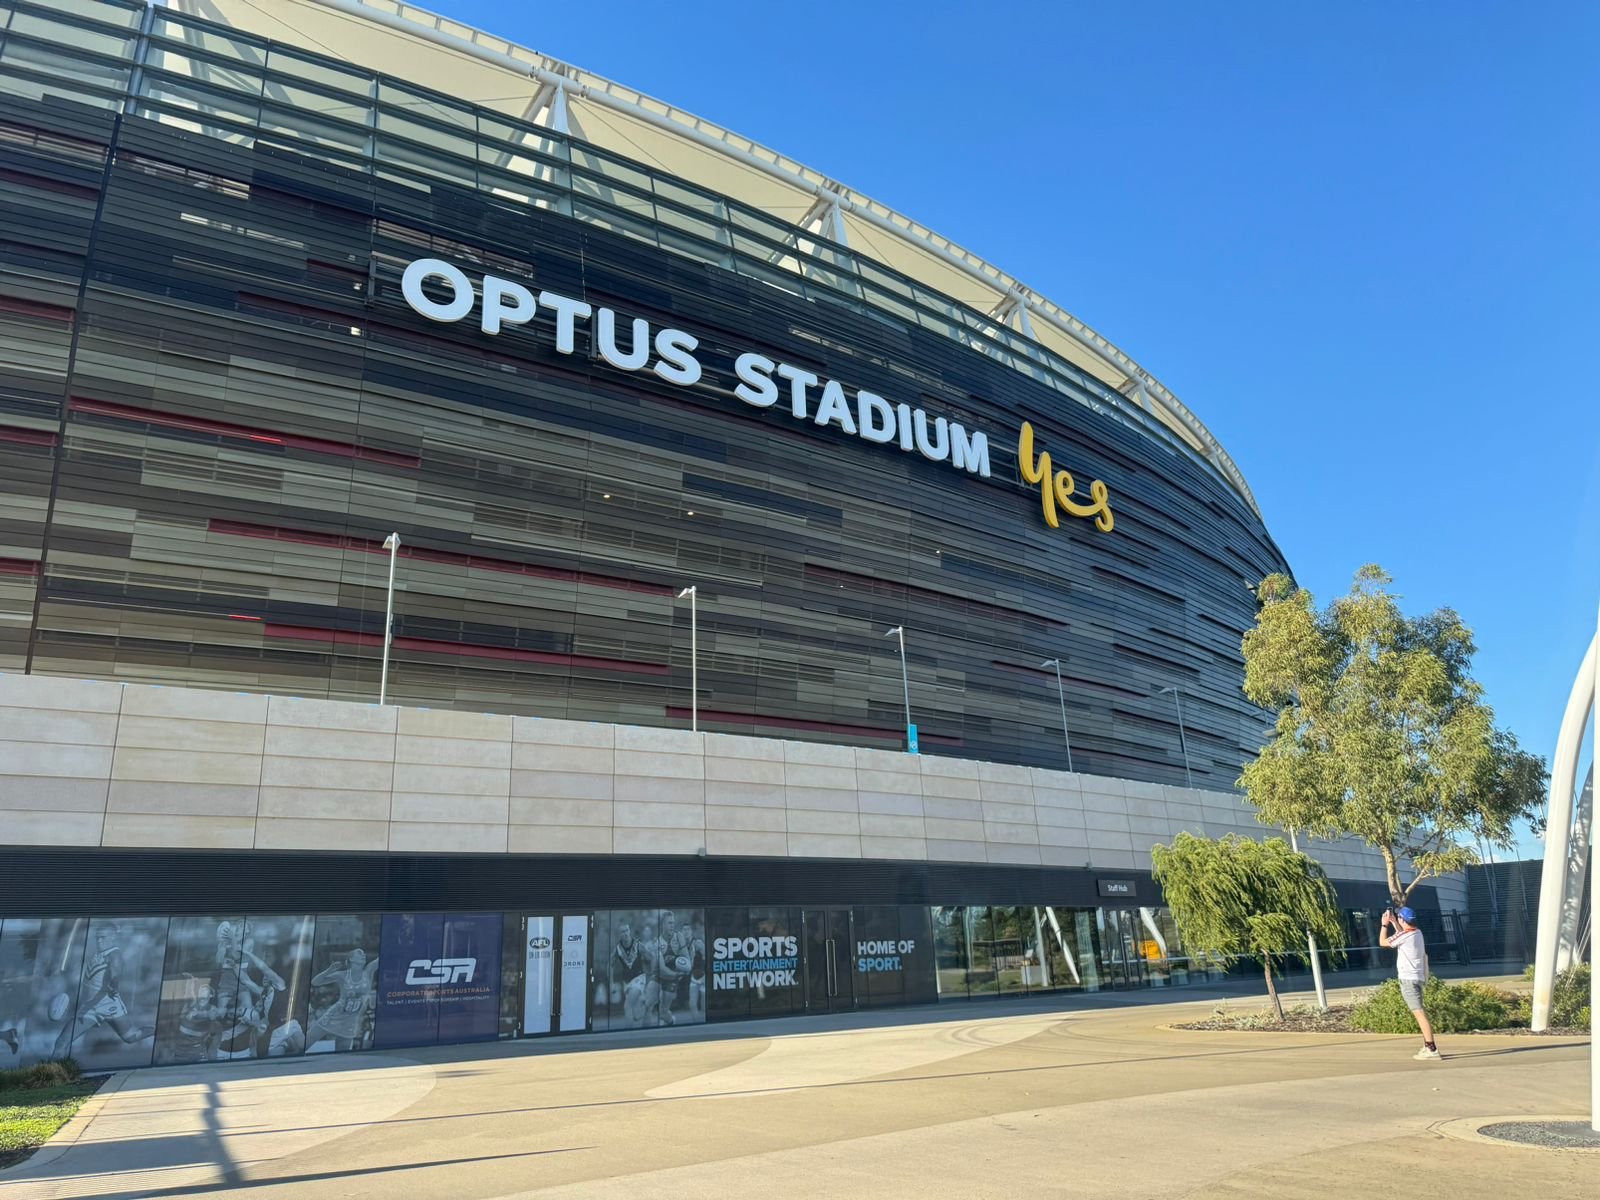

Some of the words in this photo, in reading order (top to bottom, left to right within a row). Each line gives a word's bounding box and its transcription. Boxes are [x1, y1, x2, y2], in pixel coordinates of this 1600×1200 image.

[401, 258, 701, 386] OPTUS
[734, 353, 991, 478] STADIUM
[1107, 884, 1118, 892] Staff
[1118, 884, 1128, 892] Hub
[531, 938, 549, 947] AFL
[713, 936, 798, 960] SPORTS
[857, 940, 896, 956] HOME
[898, 939, 915, 954] OF
[405, 957, 477, 985] CSA
[712, 957, 798, 973] ENTERTAINMENT
[858, 956, 902, 972] SPORT.
[712, 969, 799, 990] NETWORK.
[386, 990, 429, 999] CORPORAT
[429, 988, 453, 997] PORTS
[454, 986, 490, 995] AUSTRALIA
